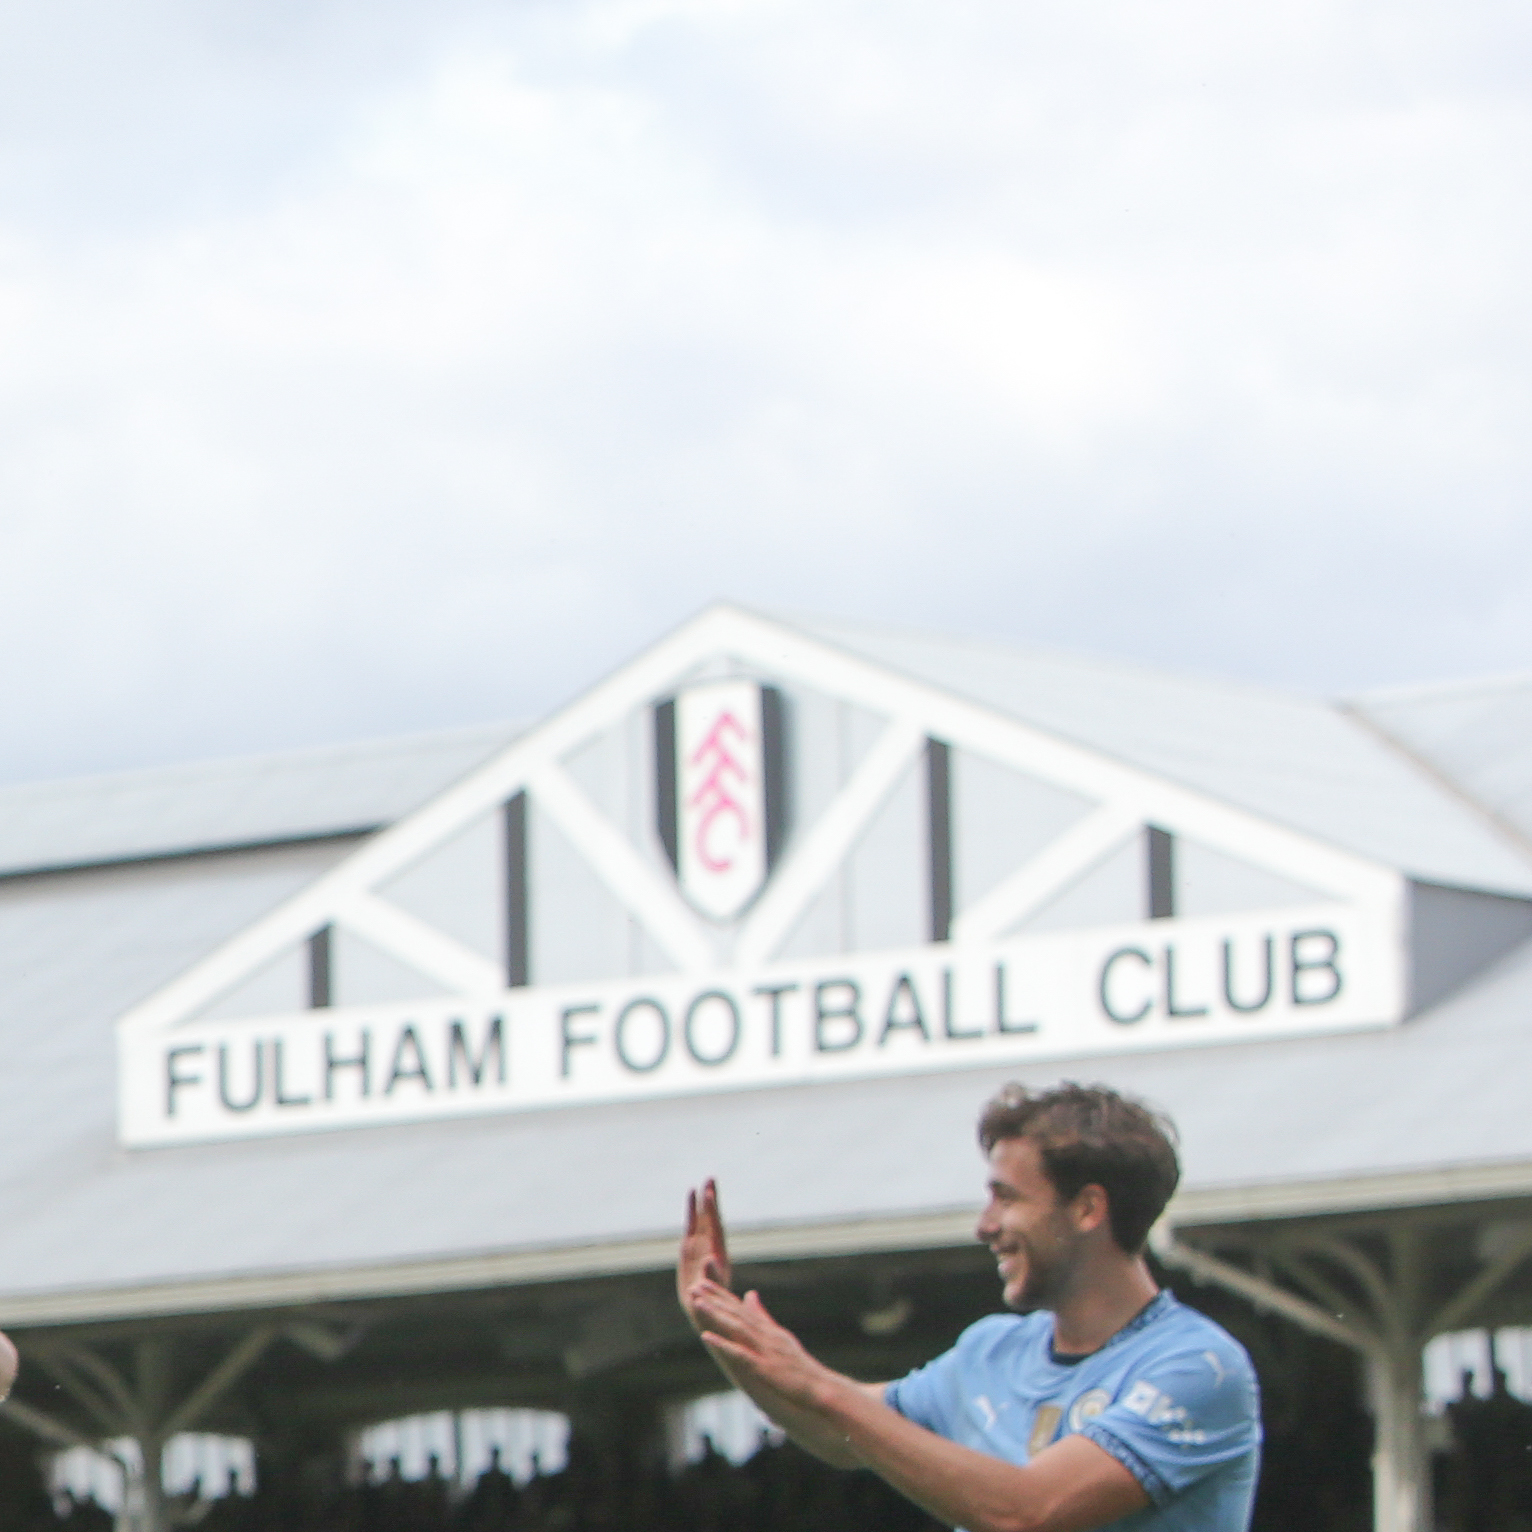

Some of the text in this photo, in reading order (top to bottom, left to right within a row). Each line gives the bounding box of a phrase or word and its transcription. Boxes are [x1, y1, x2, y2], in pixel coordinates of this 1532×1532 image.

[164, 928, 1344, 1118] FULHAM FOOTBALL CLUB
